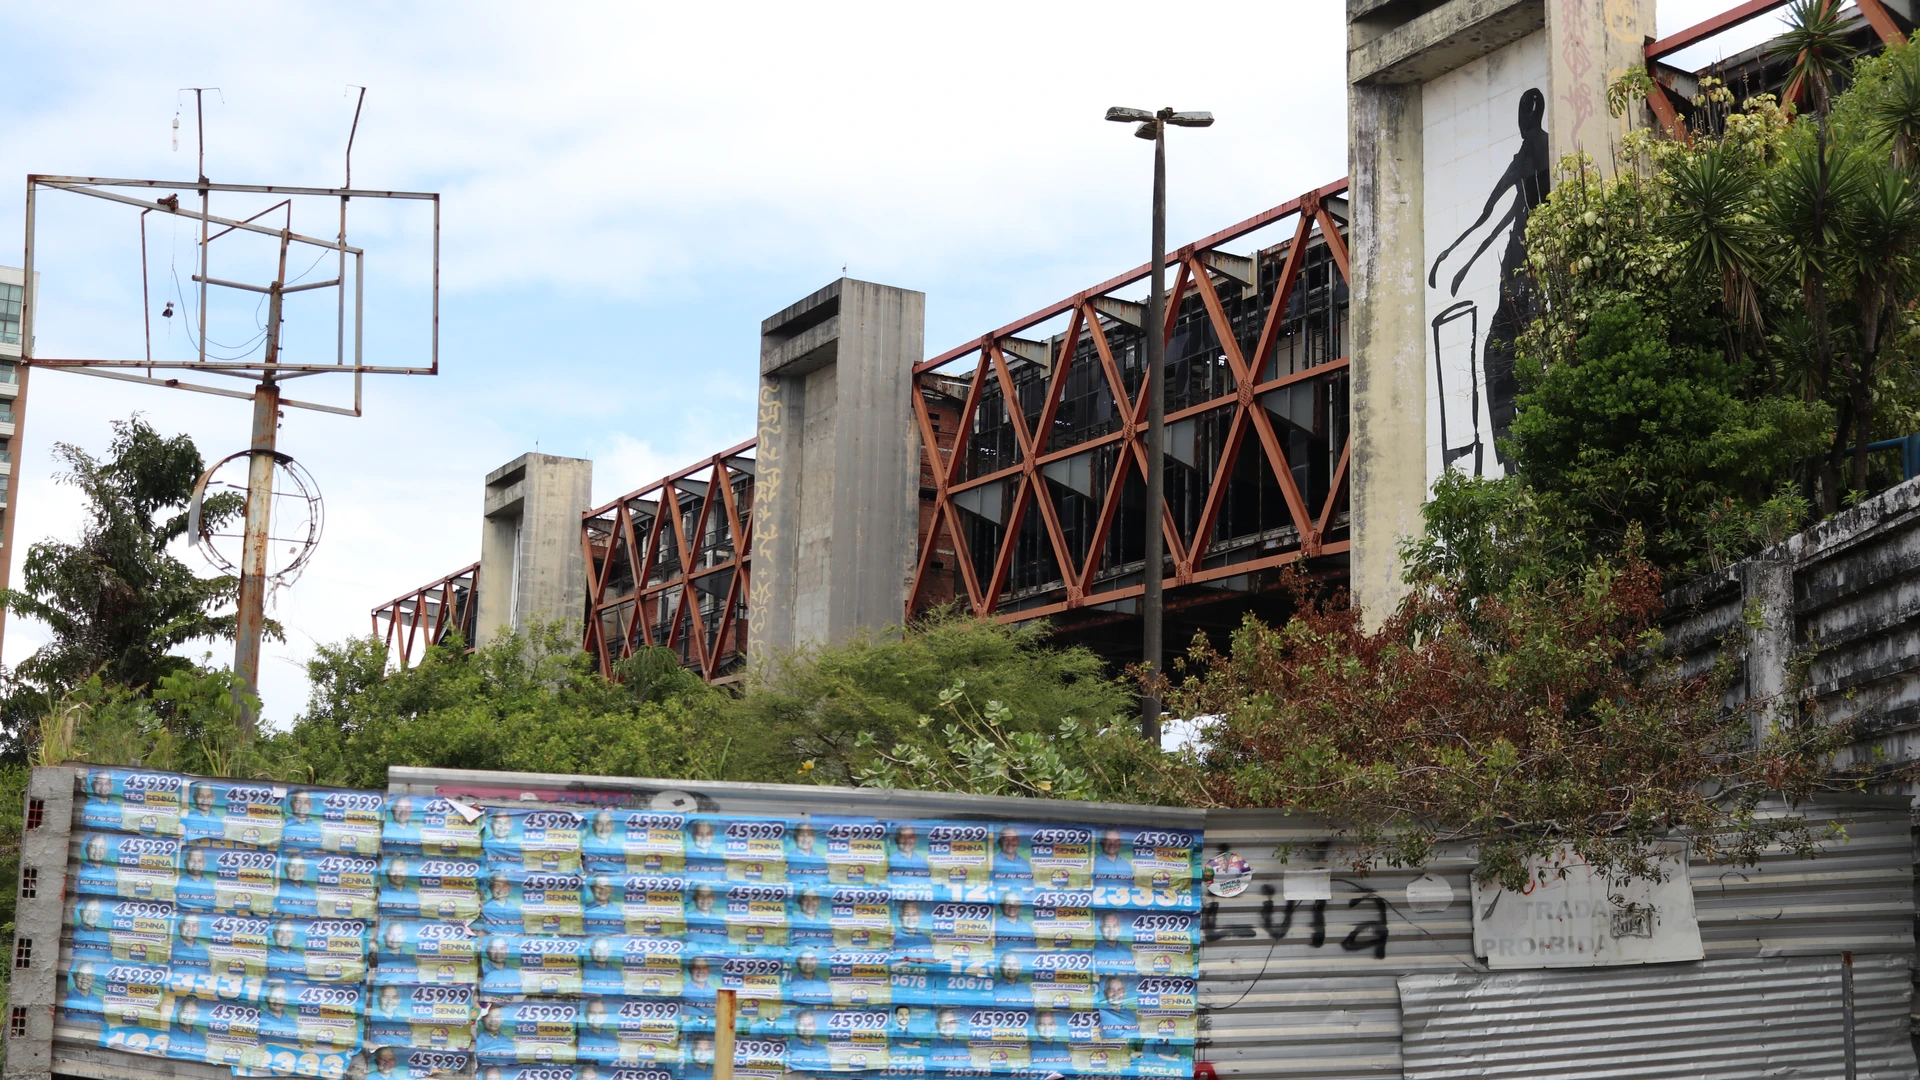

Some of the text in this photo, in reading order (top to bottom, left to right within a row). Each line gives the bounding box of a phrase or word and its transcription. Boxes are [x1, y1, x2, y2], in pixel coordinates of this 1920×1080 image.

[124, 774, 181, 792] 45999
[324, 793, 381, 810] 45999
[626, 813, 683, 830] 45999
[726, 823, 784, 839] 45999
[827, 824, 885, 840] 45999
[928, 826, 986, 841] 45999
[1031, 830, 1090, 844] 45999
[119, 839, 176, 855] 45999
[1133, 832, 1192, 847] 45999
[217, 852, 276, 869] 45999
[319, 857, 376, 873] 45999
[420, 861, 478, 877] 45999
[523, 876, 580, 891] 45999
[624, 877, 682, 892] 45999
[727, 887, 786, 901] 45999
[832, 890, 891, 904] 45999
[1033, 893, 1092, 907] 45999
[113, 902, 171, 918] 45999
[932, 905, 990, 920] 45999
[212, 917, 270, 933] 45999
[306, 921, 363, 937] 45999
[1132, 916, 1190, 930] 45999
[521, 940, 580, 953] 45999
[624, 940, 682, 953] 45999
[722, 960, 781, 974] 45999
[1032, 955, 1090, 969] 45999
[106, 966, 164, 984] 45999
[947, 977, 993, 991] 20678
[1136, 979, 1194, 994] 45999
[300, 988, 358, 1004] 45999
[413, 987, 471, 1003] 45999
[515, 1006, 575, 1022] 45999
[619, 1002, 678, 1018] 45999
[828, 1013, 887, 1028] 45999
[969, 1012, 1028, 1027] 45999
[734, 1041, 785, 1057] 5999
[408, 1052, 466, 1069] 45999
